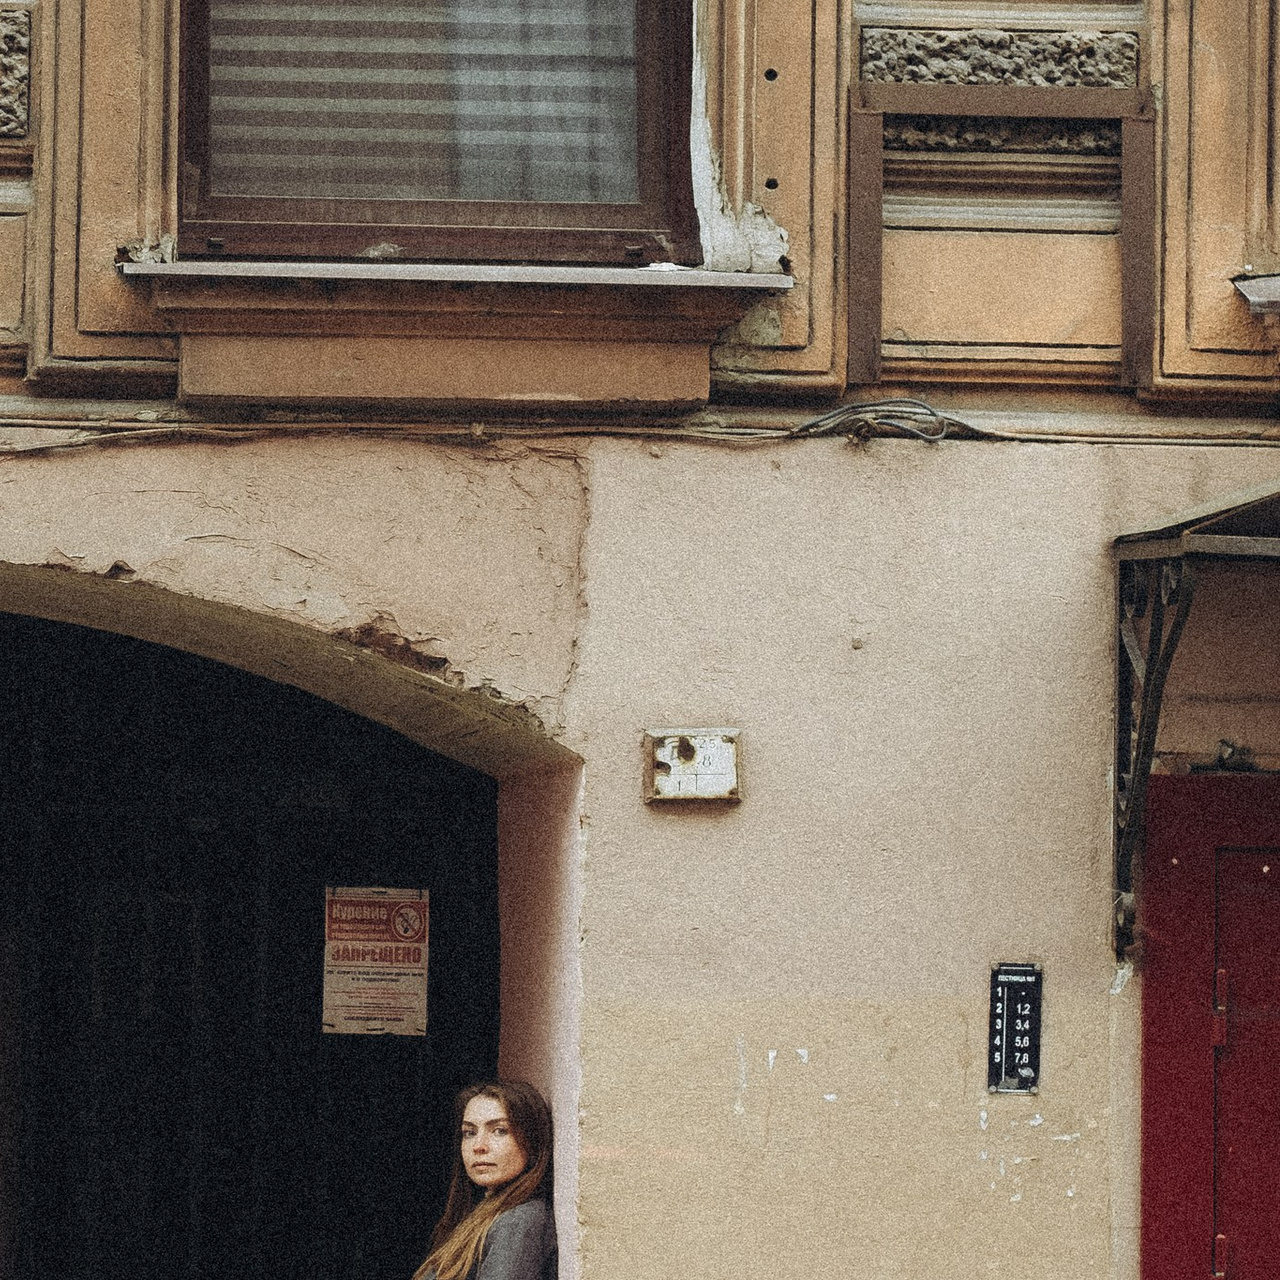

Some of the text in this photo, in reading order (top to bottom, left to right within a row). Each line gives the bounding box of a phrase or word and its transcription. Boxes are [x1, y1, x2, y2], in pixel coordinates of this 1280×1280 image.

[331, 945, 422, 965] ЗАПРЕЩЕНО
[996, 986, 1002, 997] 1
[996, 1002, 1031, 1015] 2 1,2
[995, 1019, 1030, 1031] 3 3,4
[994, 1035, 1029, 1048] 4 5,6
[994, 1052, 1029, 1065] 5 7,8
